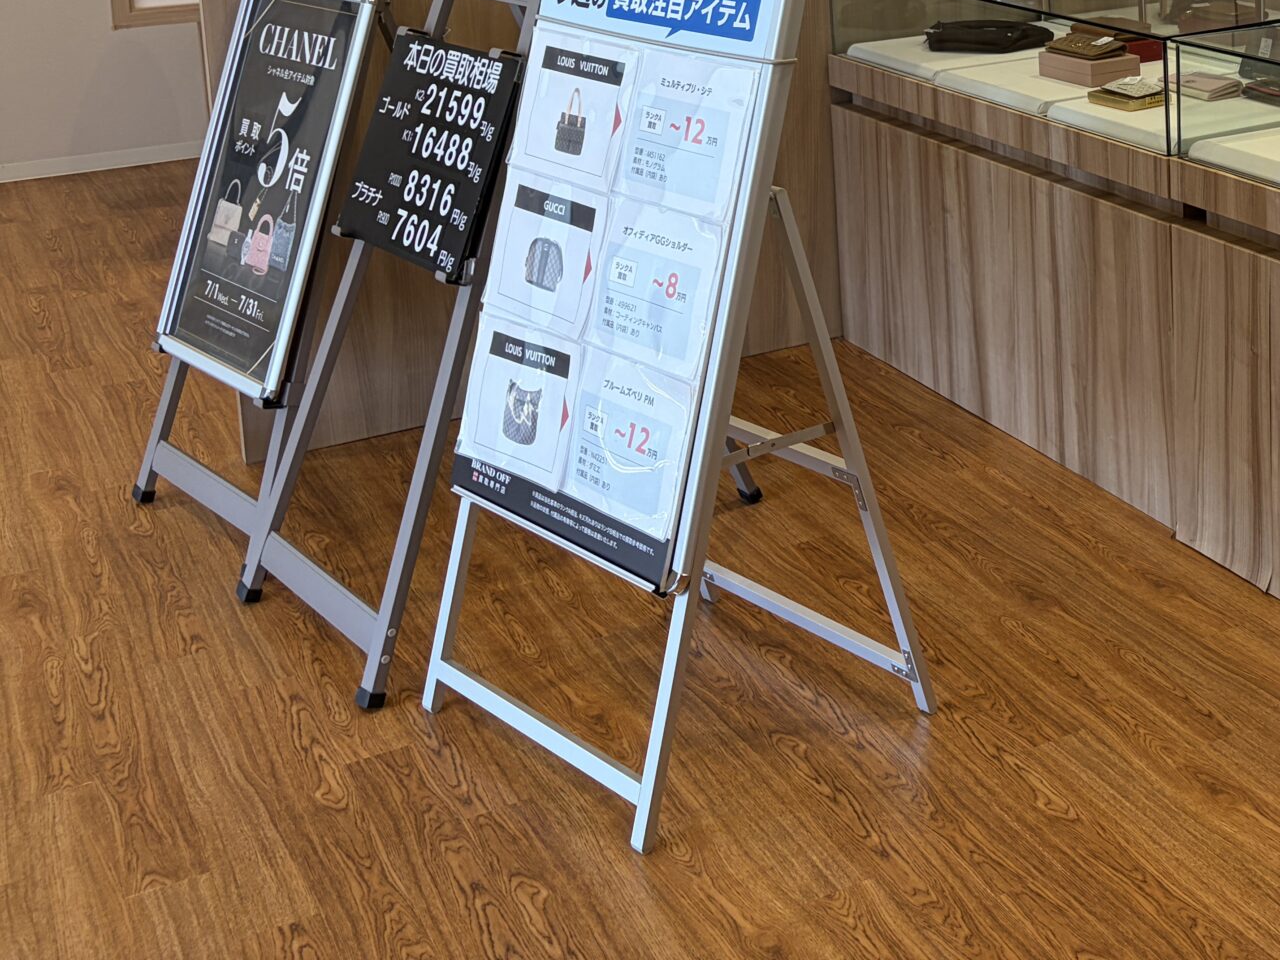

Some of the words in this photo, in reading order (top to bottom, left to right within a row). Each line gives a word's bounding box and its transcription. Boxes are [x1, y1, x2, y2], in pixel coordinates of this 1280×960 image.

[258, 23, 338, 70] CHANEL
[403, 40, 504, 94] 本日の買取相場
[557, 55, 576, 69] LOUIS
[579, 60, 610, 77] VUITTON
[379, 96, 412, 120] ゴールド
[238, 118, 262, 141] 買取
[234, 140, 256, 157] ポイント
[351, 180, 384, 207] プラチナ
[543, 200, 566, 216] GUCCI
[504, 342, 522, 357] LOUIS
[525, 348, 556, 367] VUITTON
[470, 458, 496, 478] BRAND
[496, 471, 512, 485] OFF
